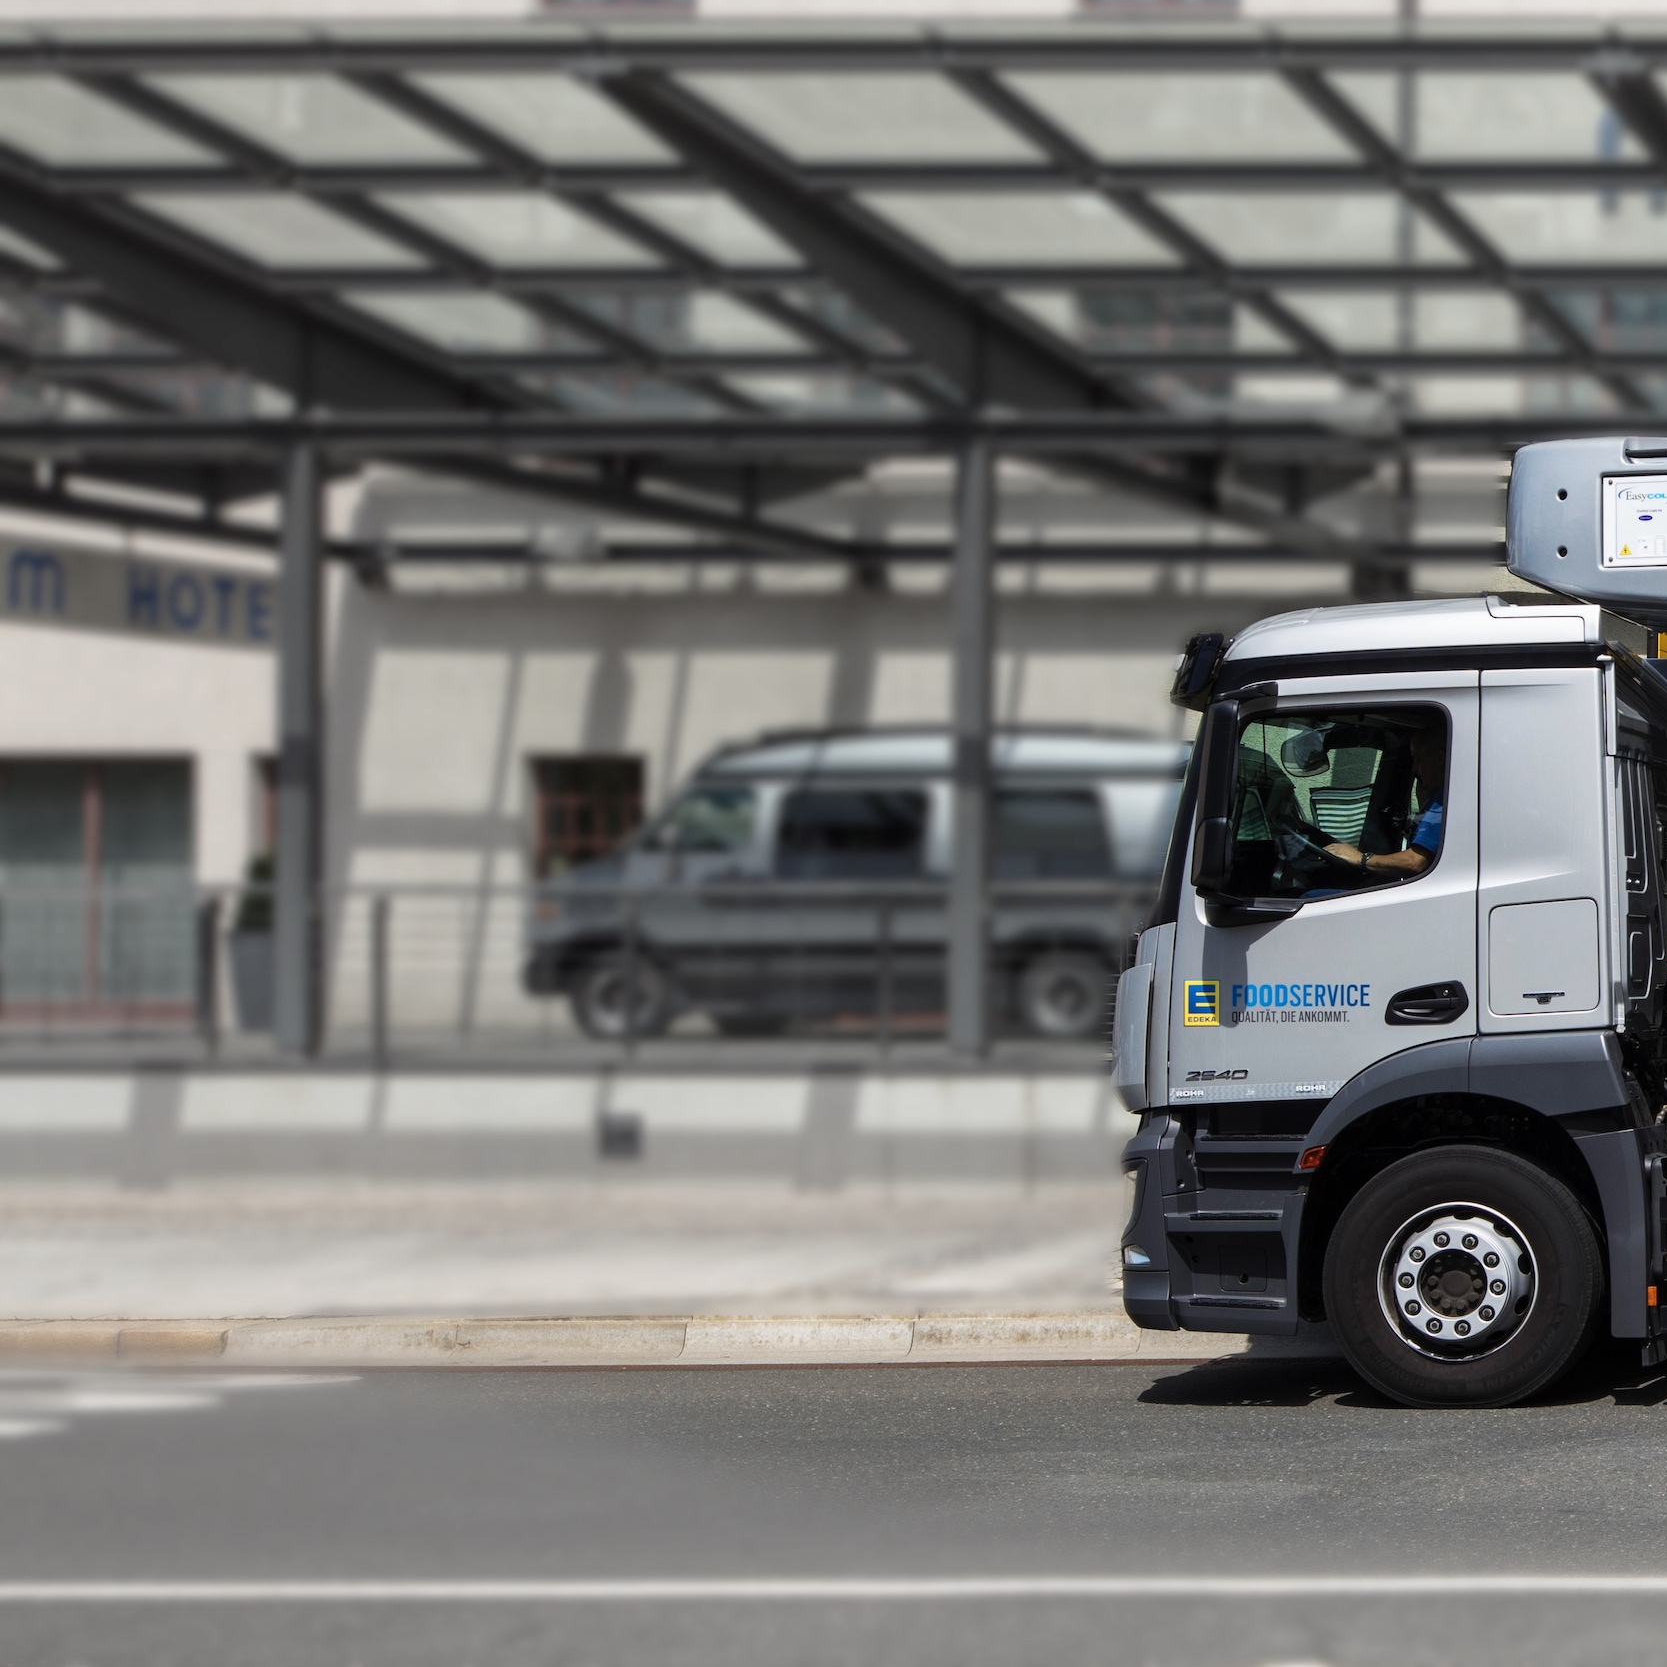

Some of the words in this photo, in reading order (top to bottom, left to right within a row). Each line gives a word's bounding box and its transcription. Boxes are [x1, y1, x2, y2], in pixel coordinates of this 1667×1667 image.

[127, 563, 274, 640] HOTE
[1231, 984, 1370, 1007] FOODSERVICE
[1231, 1008, 1279, 1024] QUALITÄT,
[1281, 1011, 1296, 1022] DIE
[1298, 1011, 1350, 1023] ANKOMMT.
[1185, 1069, 1249, 1082] 2540
[1176, 1090, 1204, 1098] ROHR
[1295, 1085, 1326, 1093] ROHR
